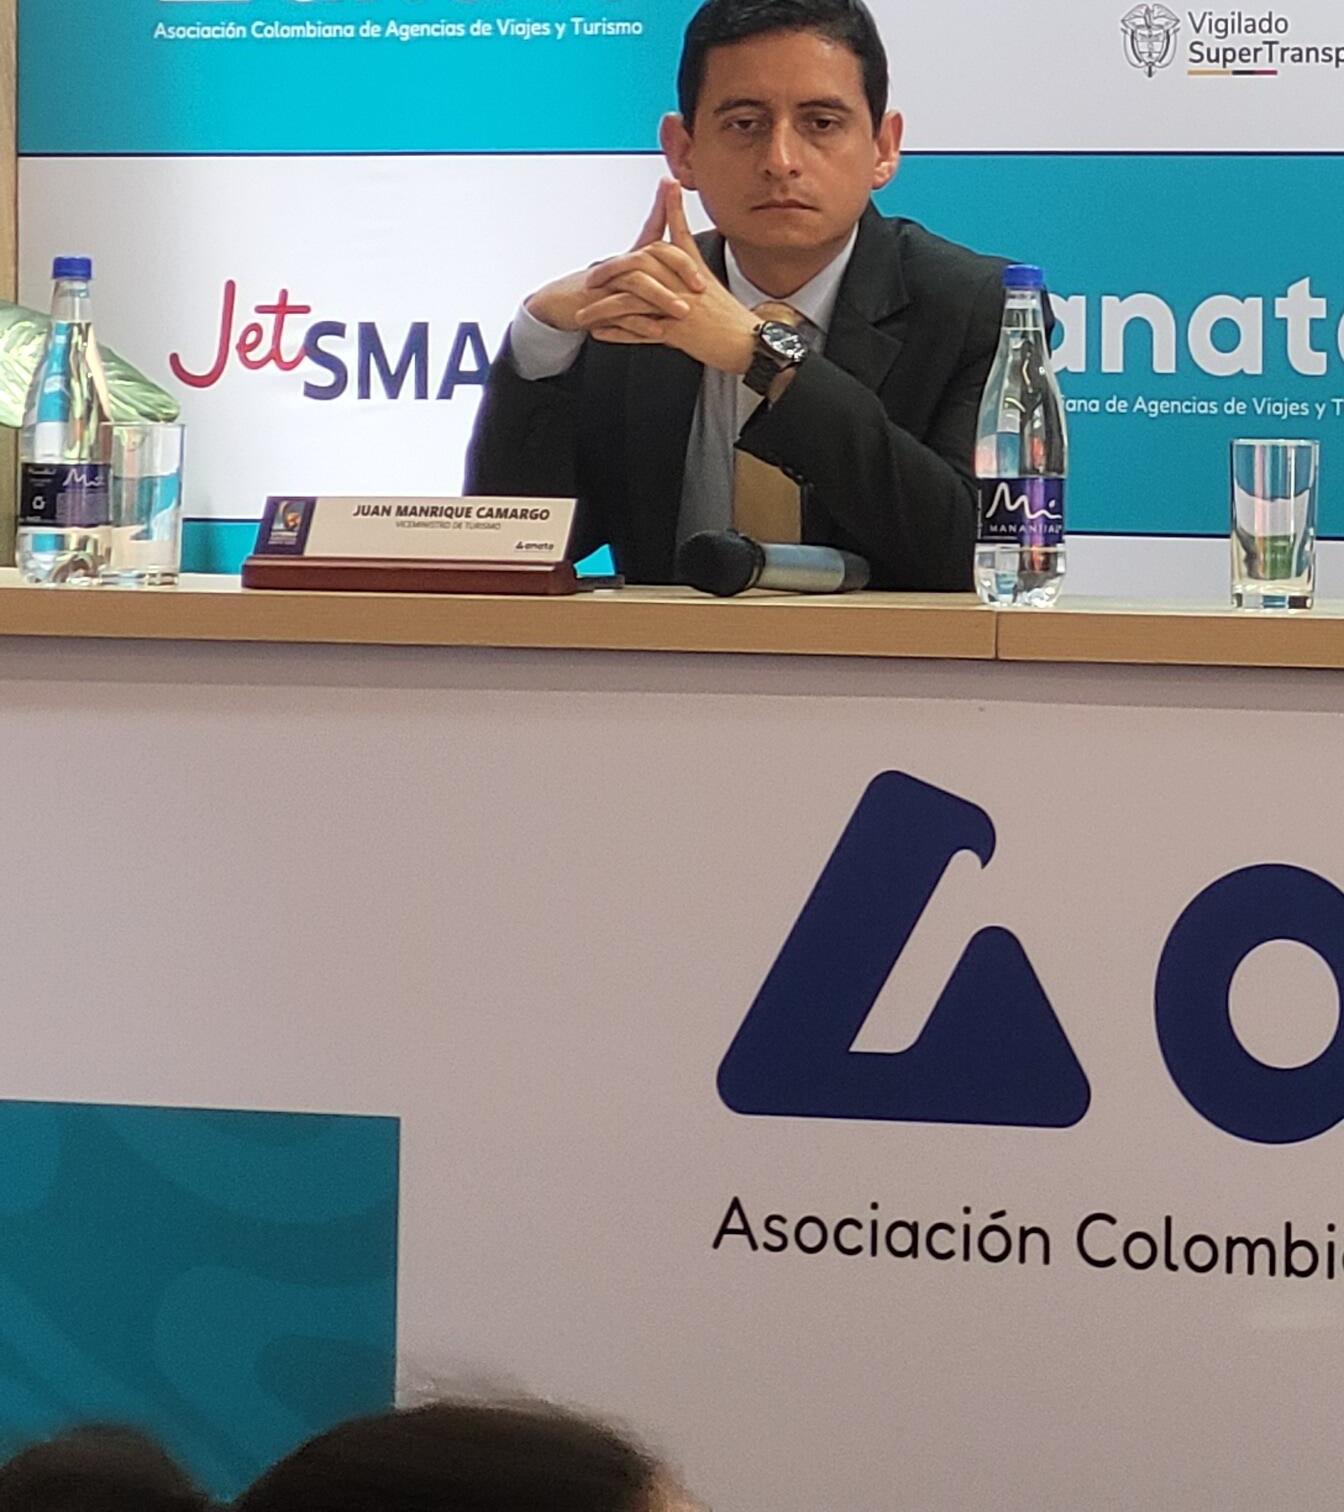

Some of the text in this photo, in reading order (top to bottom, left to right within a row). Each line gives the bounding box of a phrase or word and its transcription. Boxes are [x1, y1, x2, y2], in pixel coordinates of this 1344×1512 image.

[153, 17, 643, 42] Asociación Colombiana de Agencias de Viajes y Turismo
[1187, 10, 1289, 40] Vigilado
[1105, 395, 1129, 413] de
[1132, 395, 1218, 418] Agencias
[1223, 397, 1247, 415] de
[1252, 397, 1310, 420] Viajes
[1315, 403, 1326, 420] y
[353, 505, 550, 521] JUAN MANRIQUE CAMARGO
[712, 1196, 1050, 1266] Asociación
